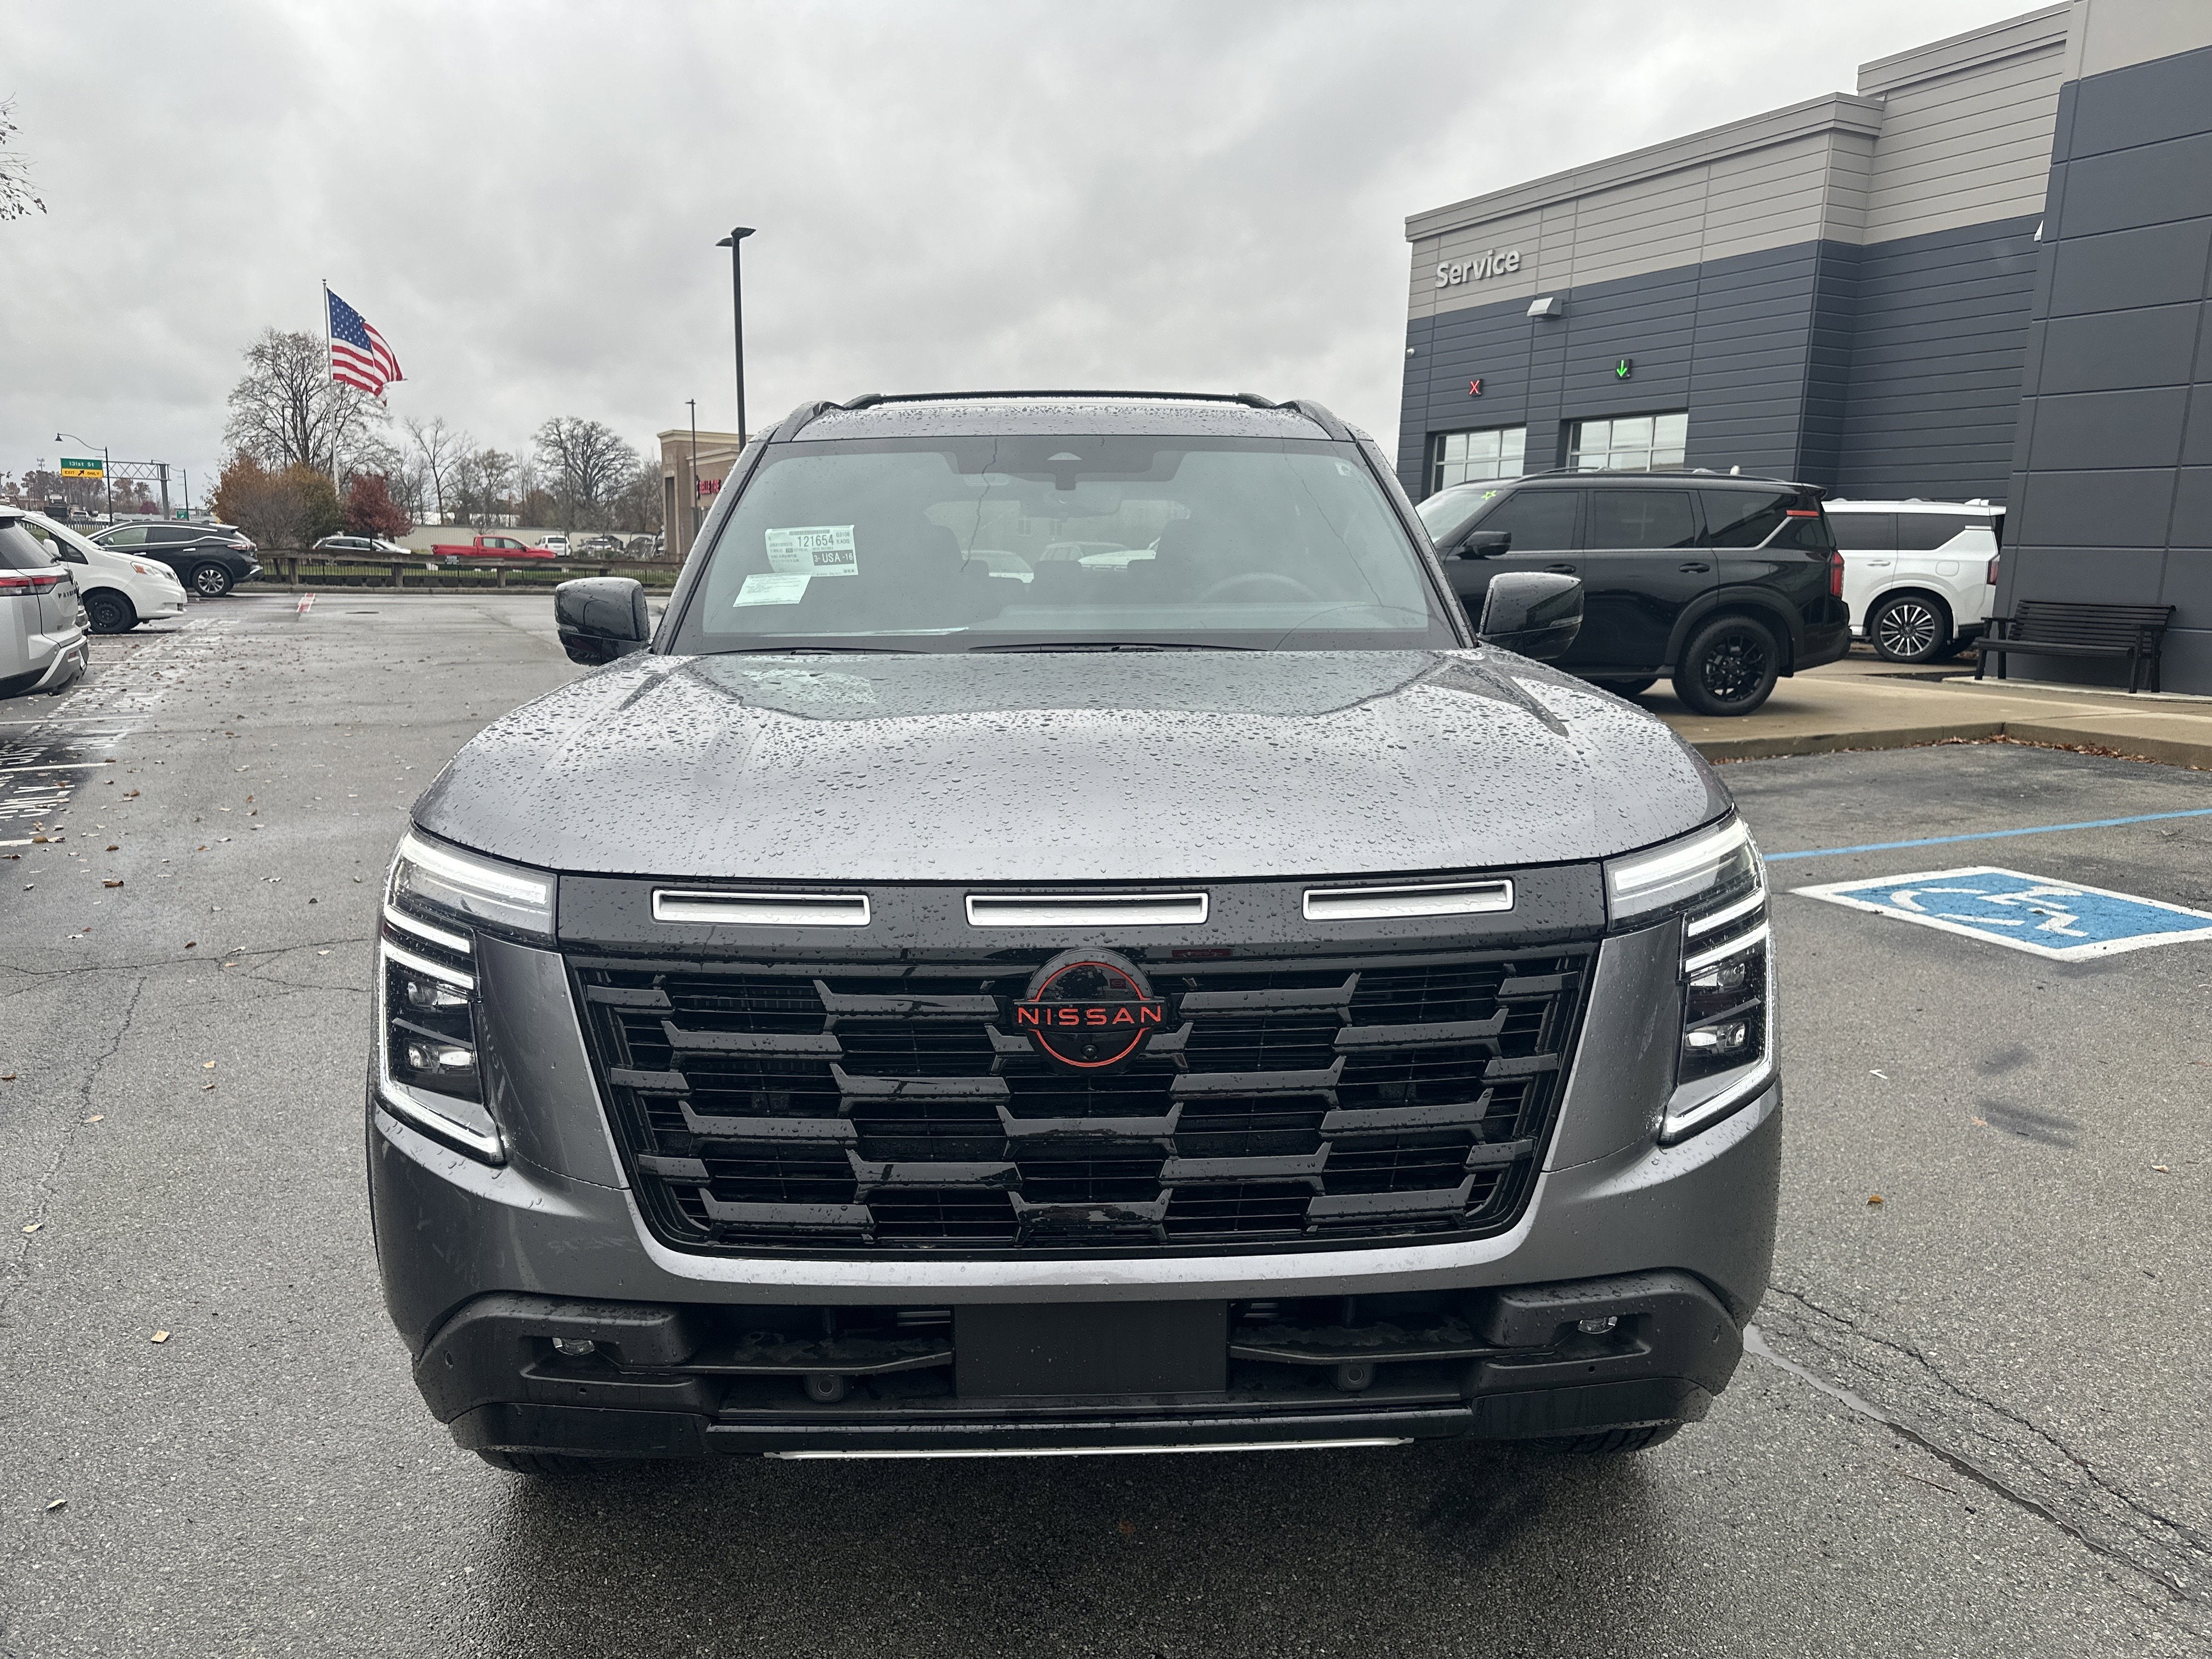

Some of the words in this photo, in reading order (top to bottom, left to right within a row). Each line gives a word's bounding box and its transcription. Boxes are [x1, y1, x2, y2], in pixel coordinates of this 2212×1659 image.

[1435, 249, 1520, 288] Service
[797, 534, 834, 548] 121654
[1018, 1005, 1161, 1025] NISSAN
